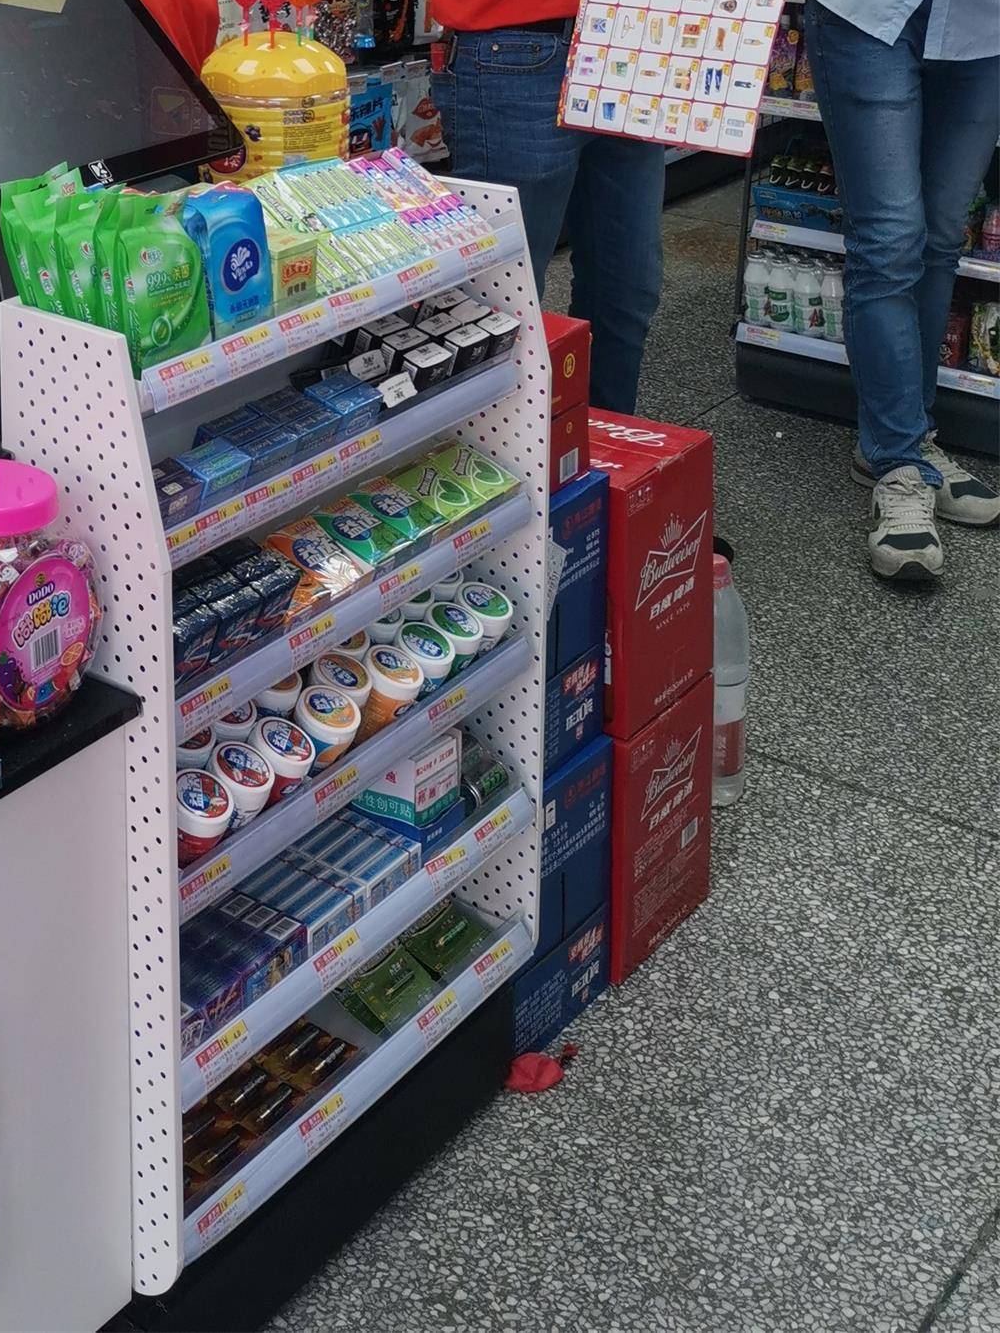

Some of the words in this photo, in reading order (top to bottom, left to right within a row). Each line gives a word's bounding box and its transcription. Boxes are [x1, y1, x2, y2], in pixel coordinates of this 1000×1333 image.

[640, 537, 701, 591] Budweiser
[28, 583, 54, 604] DODO
[645, 750, 695, 805] Budweiser
